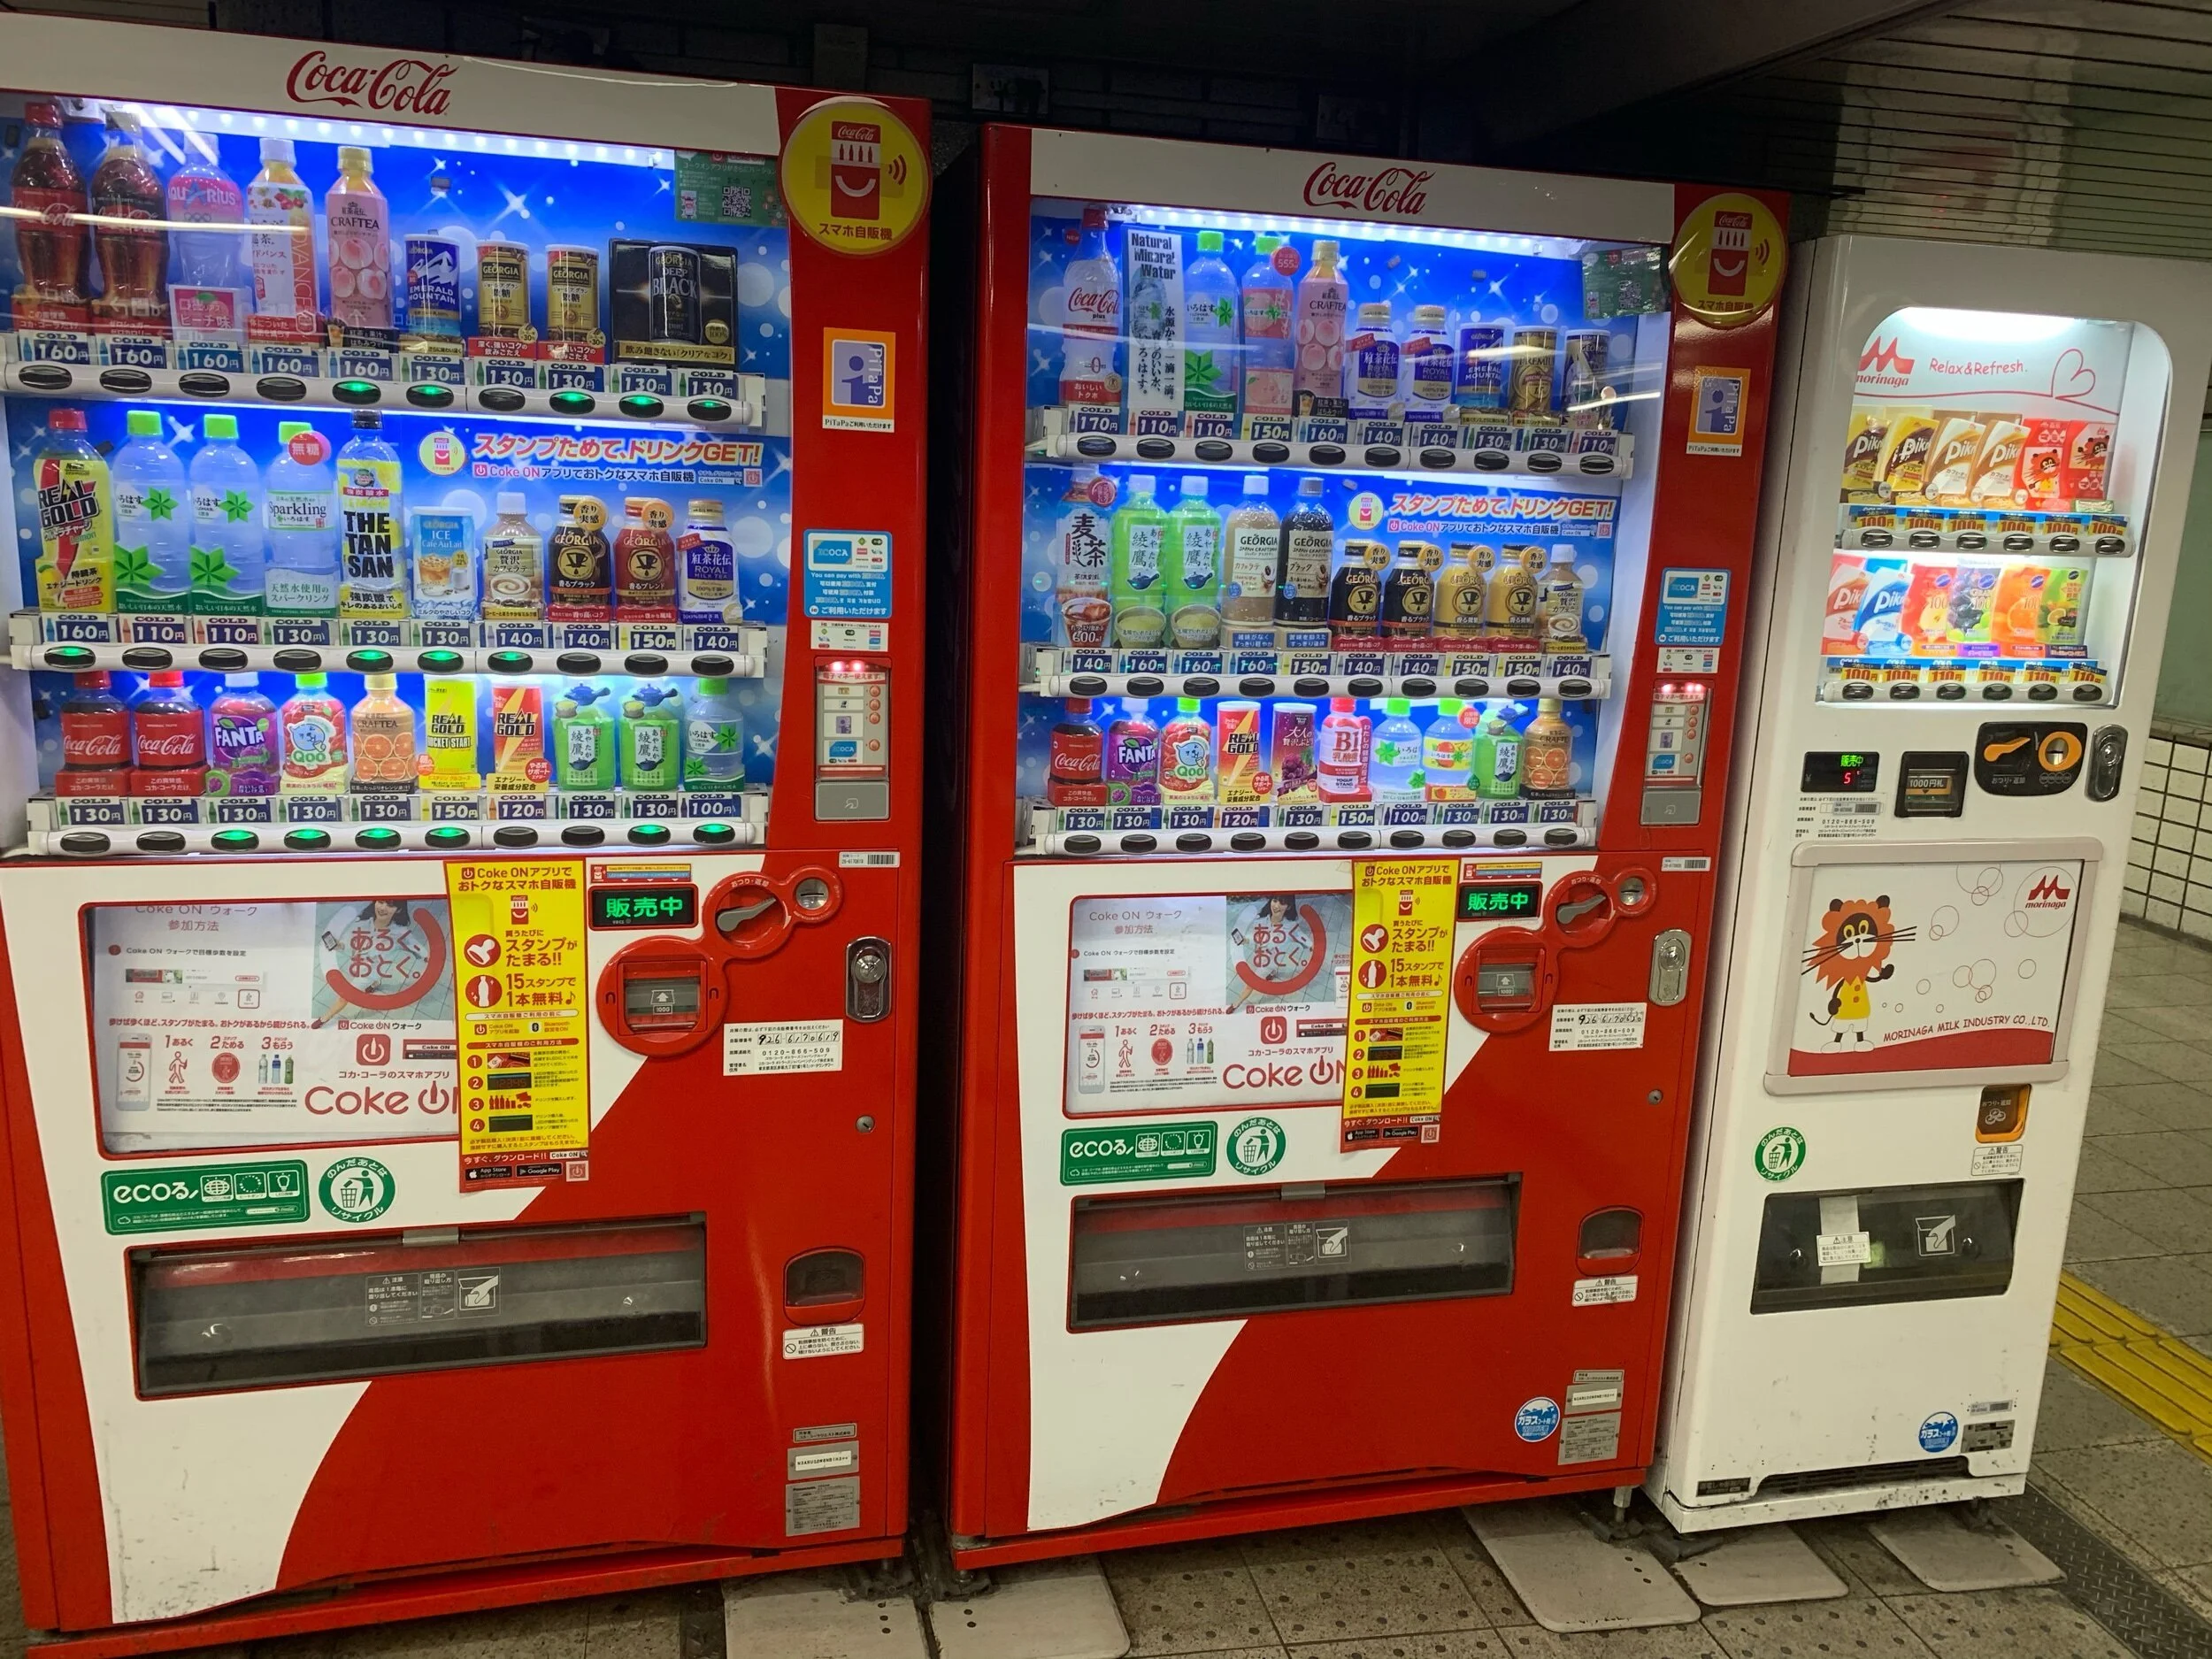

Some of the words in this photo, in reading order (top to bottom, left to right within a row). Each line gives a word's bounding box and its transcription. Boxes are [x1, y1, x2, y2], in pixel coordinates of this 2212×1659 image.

[287, 50, 459, 115] Coca-Cola
[838, 125, 876, 141] Coca-Cola
[1303, 162, 1436, 214] Coca-Cola
[331, 216, 380, 231] CRAFTEA
[819, 223, 893, 241] スマホ自販機
[1132, 234, 1172, 250] Natural
[1278, 258, 1294, 268] 555
[1141, 264, 1176, 280] Water
[410, 285, 453, 296] EMERALD
[652, 278, 697, 298] BLACK
[36, 343, 88, 361] 160円
[191, 352, 239, 369] 160円
[345, 360, 390, 377] 160円
[415, 366, 459, 381] 130円
[868, 348, 882, 403] PiTaPa
[552, 373, 595, 389] 130円
[694, 380, 733, 396] 130円
[1724, 380, 1740, 432] PiTaPa
[1079, 416, 1118, 432] 170円
[1198, 420, 1233, 436] 110円
[1310, 426, 1343, 441] 160円
[1367, 428, 1401, 442] 140円
[1479, 434, 1510, 449] 130円
[1582, 440, 1614, 452] 110円
[292, 442, 319, 456] 無糖
[473, 434, 762, 465] スタンプためて、ドリンクGET!
[269, 502, 326, 517] Sparkling
[580, 505, 597, 514] 香り
[1392, 494, 1615, 520] スタンプためて、ドリンクGET!
[344, 511, 389, 533] THE
[580, 515, 599, 524] 実感
[432, 531, 450, 540] ICE
[345, 534, 391, 554] TAN
[1133, 533, 1147, 567] 綾鷹
[692, 553, 732, 565] 紅茶花伝
[1427, 548, 1439, 557] 香り
[348, 557, 394, 578] SAN
[1425, 557, 1440, 565] 実感
[272, 584, 328, 593] 天然水使用の
[272, 594, 329, 603] スパークリング
[60, 624, 109, 640] 160円
[211, 626, 257, 641] 110円
[355, 628, 399, 643] 130円
[426, 631, 468, 645] 130円
[567, 633, 610, 647] 140円
[697, 635, 737, 649] 140円
[1075, 657, 1110, 671] 140円
[1185, 661, 1218, 673] 160円
[1292, 661, 1327, 674] 150円
[1348, 662, 1380, 674] 140円
[1455, 663, 1487, 676] 150円
[1555, 664, 1587, 676] 140円
[433, 711, 465, 725] REAL
[498, 710, 535, 726] REAL
[431, 723, 465, 734] GOLD
[497, 724, 535, 738] GOLD
[215, 726, 265, 746] FANTA
[64, 734, 121, 756] Coca-Cola
[138, 734, 196, 756] Coca-Cola
[638, 730, 651, 758] 綾鷹
[292, 750, 326, 763] Qoo
[1840, 755, 1863, 767] 販売中
[1176, 765, 1204, 777] Qoo
[1909, 779, 1944, 787] 1000円札
[73, 808, 121, 821] 130円
[222, 808, 266, 822] 130円
[365, 804, 407, 818] 130円
[435, 804, 478, 818] 150円
[573, 804, 614, 818] 130円
[691, 802, 733, 816] 100円
[1446, 810, 1479, 822] 130円
[1542, 809, 1573, 820] 130円
[1068, 817, 1103, 827] 130円
[1173, 815, 1206, 826] 130円
[1288, 814, 1320, 825] 130円
[1340, 812, 1373, 824] 150円
[457, 879, 576, 891] おトクなスマホ自販機
[1362, 876, 1452, 887] おトクなスマホ自販機
[606, 896, 683, 918] 販売中
[1468, 893, 1528, 910] 販売中
[2025, 900, 2066, 910] morinaga
[1089, 911, 1119, 921] Coke
[1123, 911, 1140, 920] ON
[1146, 910, 1181, 919] ウォーク
[168, 920, 219, 932] 参加方法
[1115, 926, 1153, 934] 参加方法
[349, 928, 421, 952] あるく、
[1253, 924, 1307, 944] あるく、
[1393, 928, 1448, 941] スタンプが
[506, 937, 577, 952] スタンプが
[506, 953, 561, 966] たまる!!
[1253, 947, 1307, 967] おとく。
[349, 955, 421, 979] おとく。
[1391, 958, 1444, 972] 15スタンプで
[506, 973, 576, 989] 15スタンプで
[1883, 1025, 1933, 1042] MORINAGA
[1937, 1021, 1960, 1032] MILK
[1963, 1015, 2010, 1027] INDUSTRY
[1248, 1047, 1333, 1056] コカ・コーラのスマホアプリ
[339, 1071, 449, 1079] コカ・コーラのスマホアプリ
[1223, 1064, 1302, 1089] Coke
[1233, 1118, 1281, 1138] のんだあとは
[1761, 1128, 1805, 1148] のんだあとは
[465, 1153, 547, 1164] 今すぐ、ダウンロード!!
[326, 1159, 388, 1179] のんだあとは
[1234, 1159, 1277, 1174] リサイクル
[1760, 1164, 1798, 1180] リサイクル
[331, 1205, 385, 1222] リサイクル
[1517, 1416, 1538, 1425] ガラス
